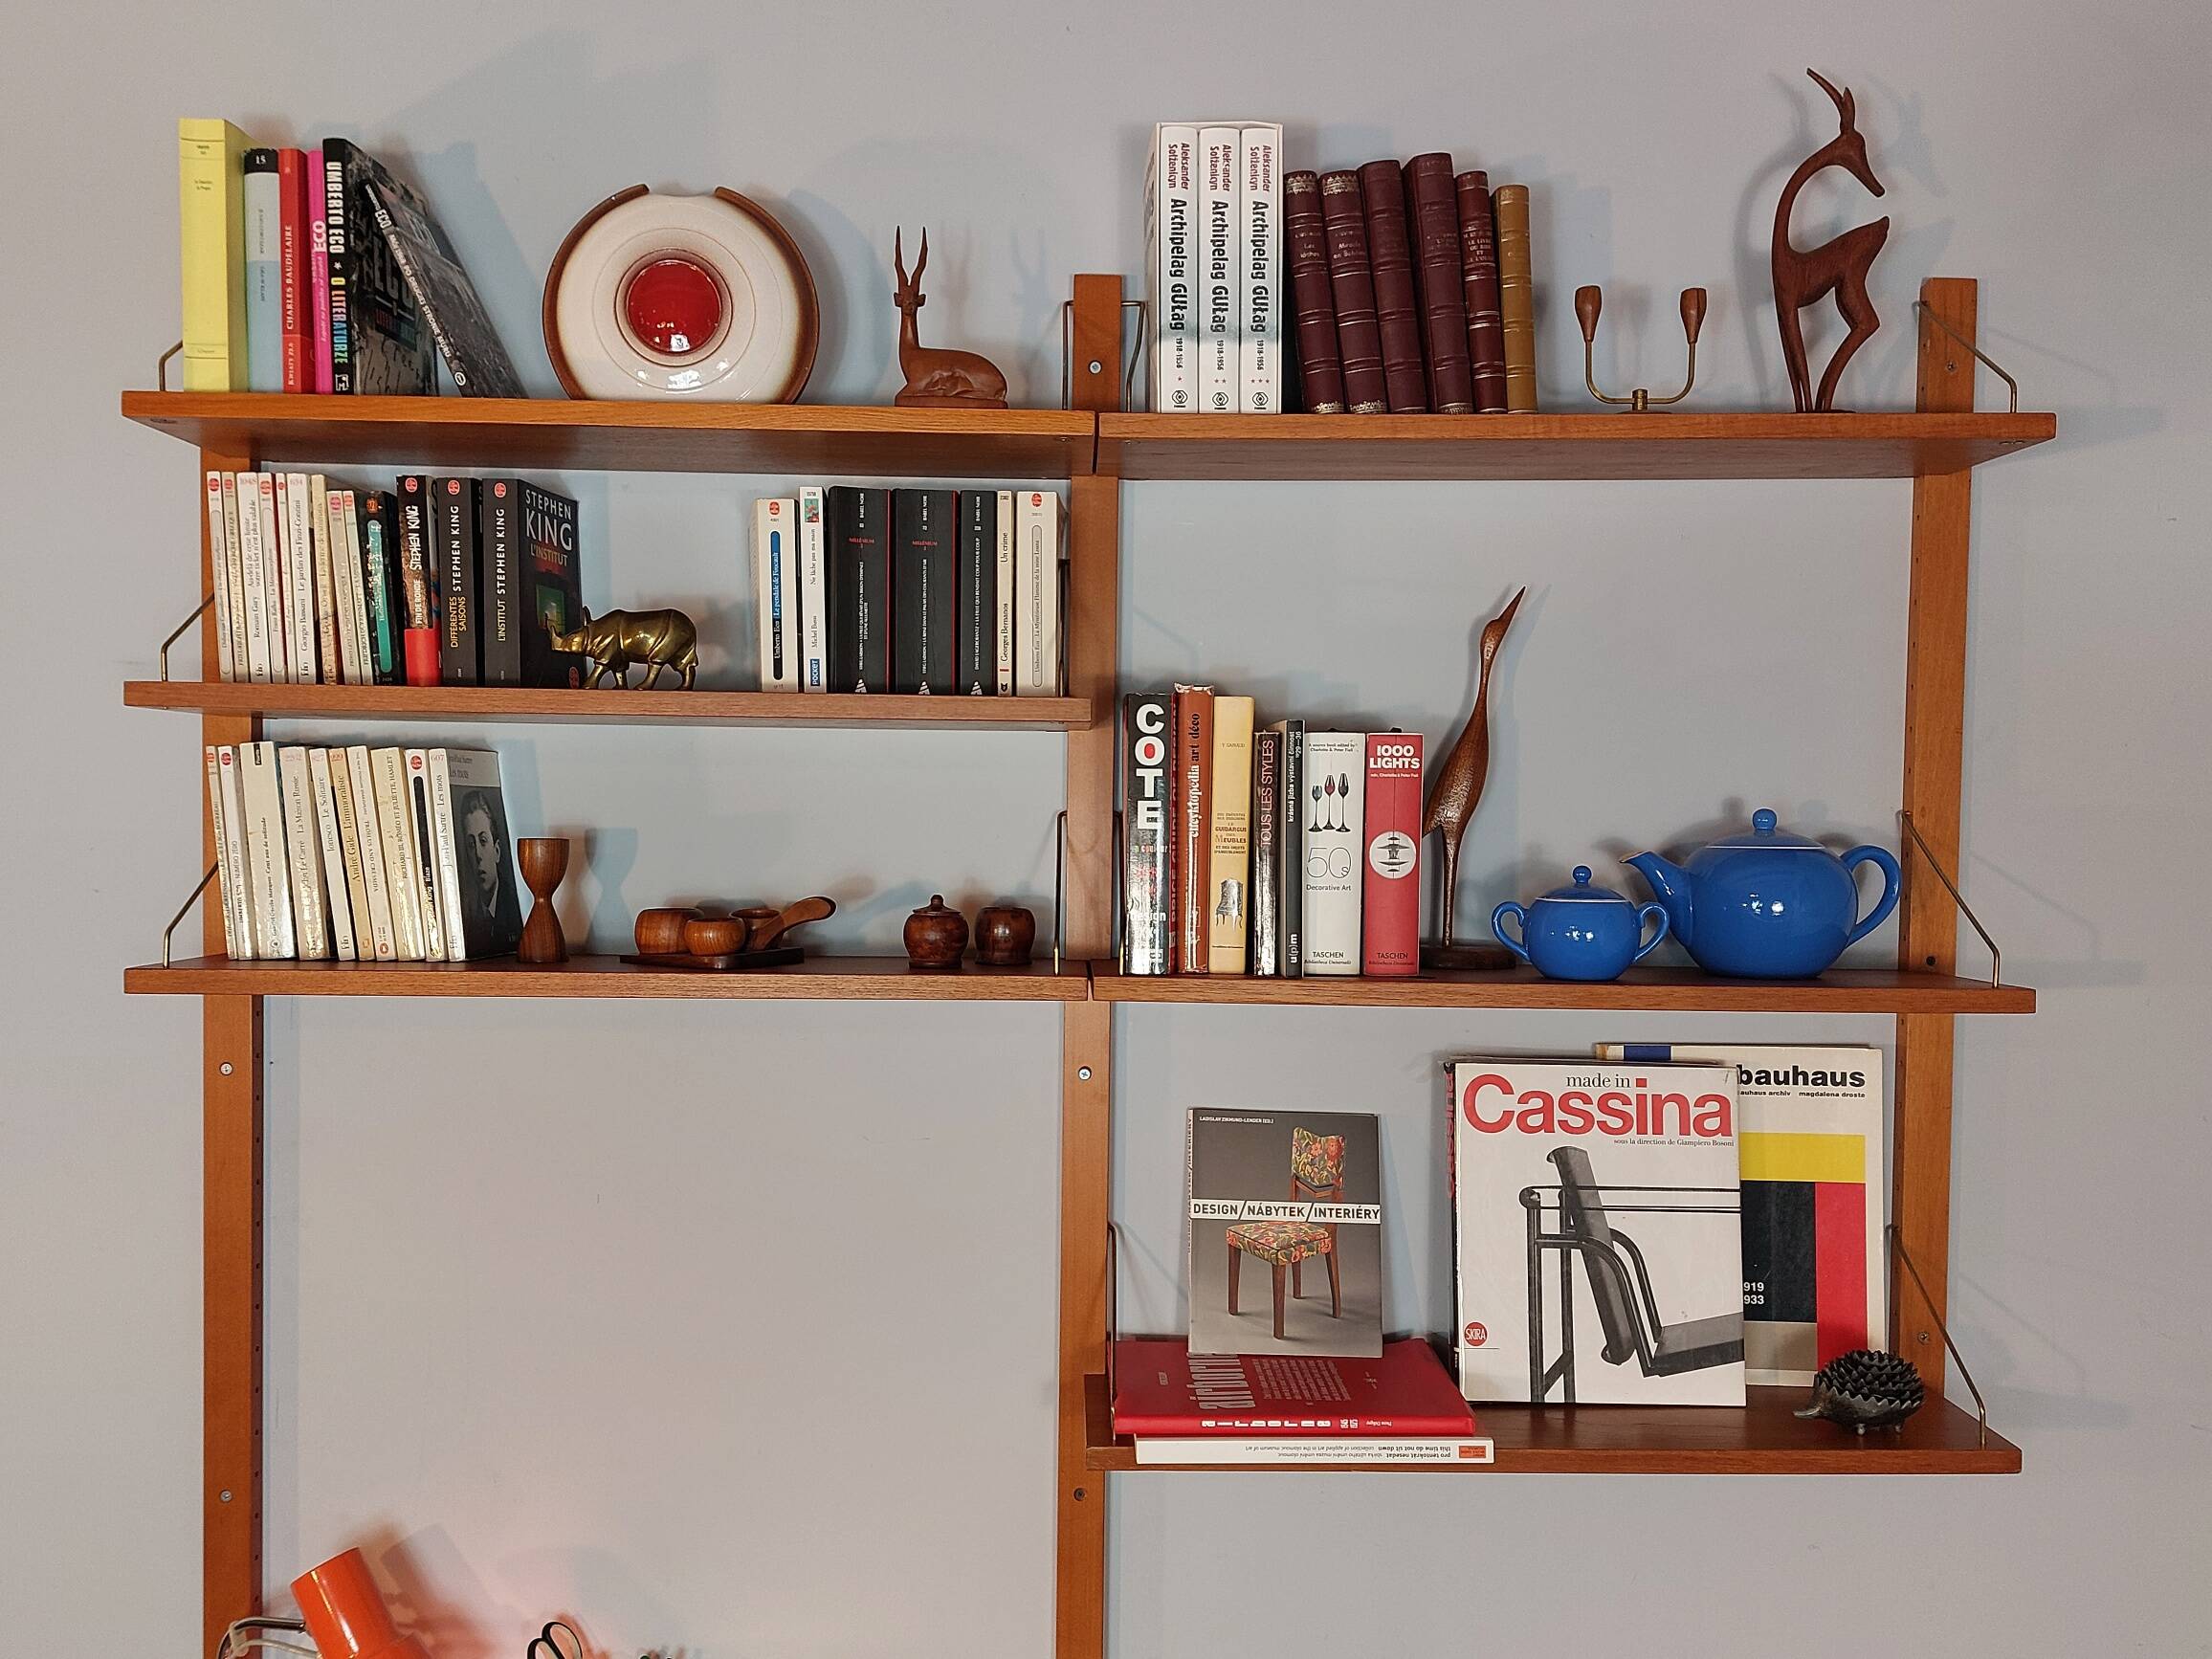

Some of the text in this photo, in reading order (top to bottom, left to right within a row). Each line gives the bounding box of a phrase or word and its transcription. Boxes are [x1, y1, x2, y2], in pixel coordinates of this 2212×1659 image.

[1182, 143, 1190, 189] Aleksander
[1223, 144, 1231, 191] Aleksander
[1263, 144, 1272, 192] Aleksander
[326, 162, 344, 254] UMBERTO ECO
[375, 209, 391, 229] ECO
[313, 220, 326, 253] ECO
[1169, 198, 1187, 277] Archipelag
[1210, 200, 1228, 280] Archipelag
[1250, 200, 1270, 280] Archipelag
[284, 225, 294, 329] CHARLES BAUDELAIRE
[330, 276, 347, 364] O LITERATURZE
[408, 505, 420, 529] KING
[525, 489, 572, 520] STEPHEN
[526, 507, 572, 551] KING
[409, 533, 422, 570] STEPHEN
[450, 504, 461, 592] STEPHEN KING
[530, 542, 568, 566] L'INSTITUT
[1001, 553, 1007, 563] Un
[298, 561, 306, 581] jardin
[496, 508, 506, 641] L'INSTITUT STEPHEN KING
[299, 582, 305, 590] Le
[416, 603, 422, 612] DE
[458, 596, 467, 631] SAISONS
[1188, 713, 1200, 739] déco
[1188, 742, 1200, 762] art
[1369, 757, 1421, 769] LIGHTS
[1377, 744, 1414, 757] 1000
[1135, 703, 1164, 830] COTE
[1261, 740, 1274, 848] TOUS LES STYLES
[319, 777, 335, 852] Ionesco Le Solitaire
[439, 812, 448, 833] Sartre
[298, 825, 304, 833] La
[346, 836, 356, 855] Gide
[300, 861, 307, 871] Le
[1289, 933, 1298, 963] u(p)m
[1566, 1072, 1631, 1088] made in
[1736, 1064, 1866, 1088] bauhaus
[1463, 1073, 1733, 1138] Cassina
[1676, 1139, 1711, 1147] Giampiero
[1193, 1203, 1380, 1220] DESIGN NÁBYTEK INTERIÉRY
[1743, 1281, 1765, 1292] 919
[1743, 1294, 1765, 1305] 933
[1466, 1328, 1486, 1341] SKIRA
